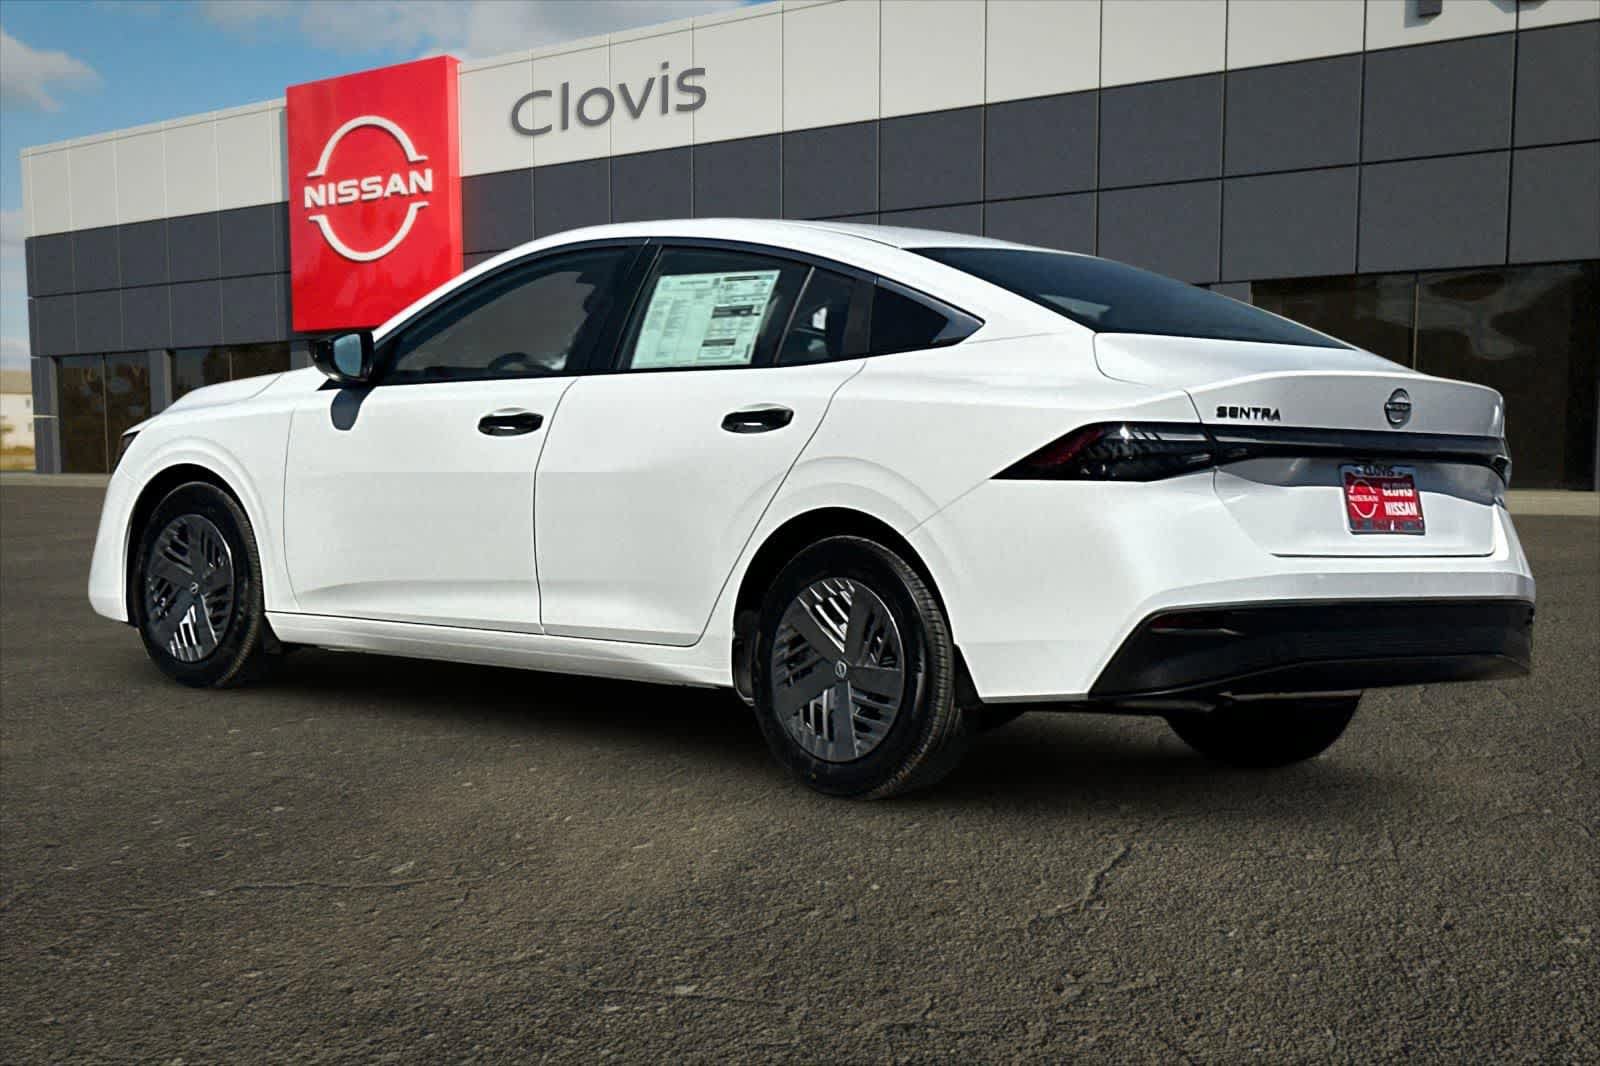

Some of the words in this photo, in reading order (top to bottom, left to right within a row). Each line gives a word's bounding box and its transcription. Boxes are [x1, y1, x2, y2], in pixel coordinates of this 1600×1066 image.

[511, 61, 707, 136] Clovis
[304, 168, 433, 209] NISSAN
[1216, 406, 1281, 421] SENTRA
[1383, 501, 1418, 516] NISSAN
